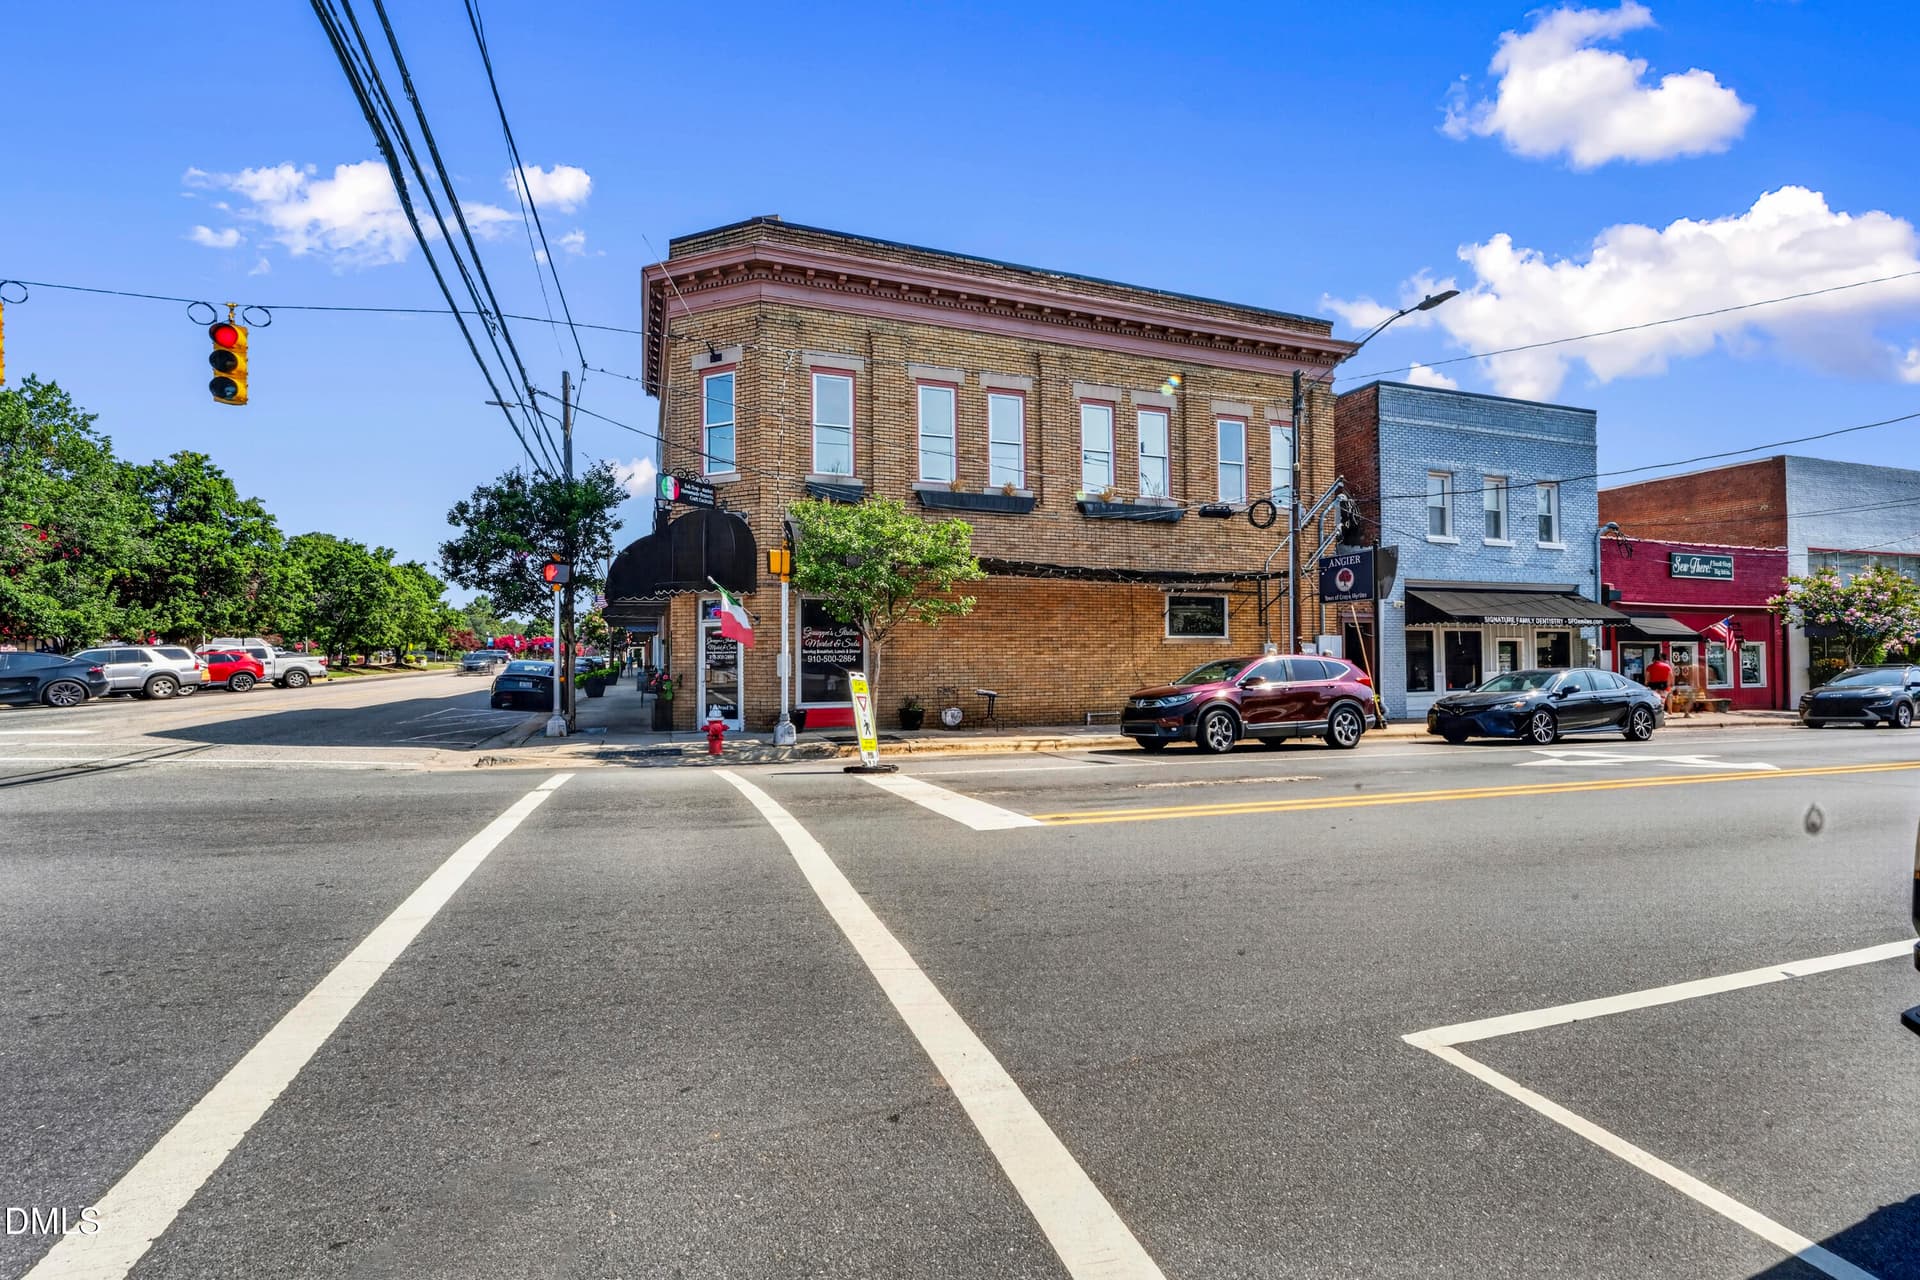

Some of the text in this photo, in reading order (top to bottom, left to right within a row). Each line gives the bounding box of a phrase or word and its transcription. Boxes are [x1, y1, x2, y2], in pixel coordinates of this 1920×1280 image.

[1328, 555, 1361, 568] ANGIER
[1672, 556, 1690, 573] Sew
[1516, 616, 1534, 624] FAMILY
[1536, 617, 1563, 625] DENTISTRY
[808, 655, 857, 663] 910-500-2864
